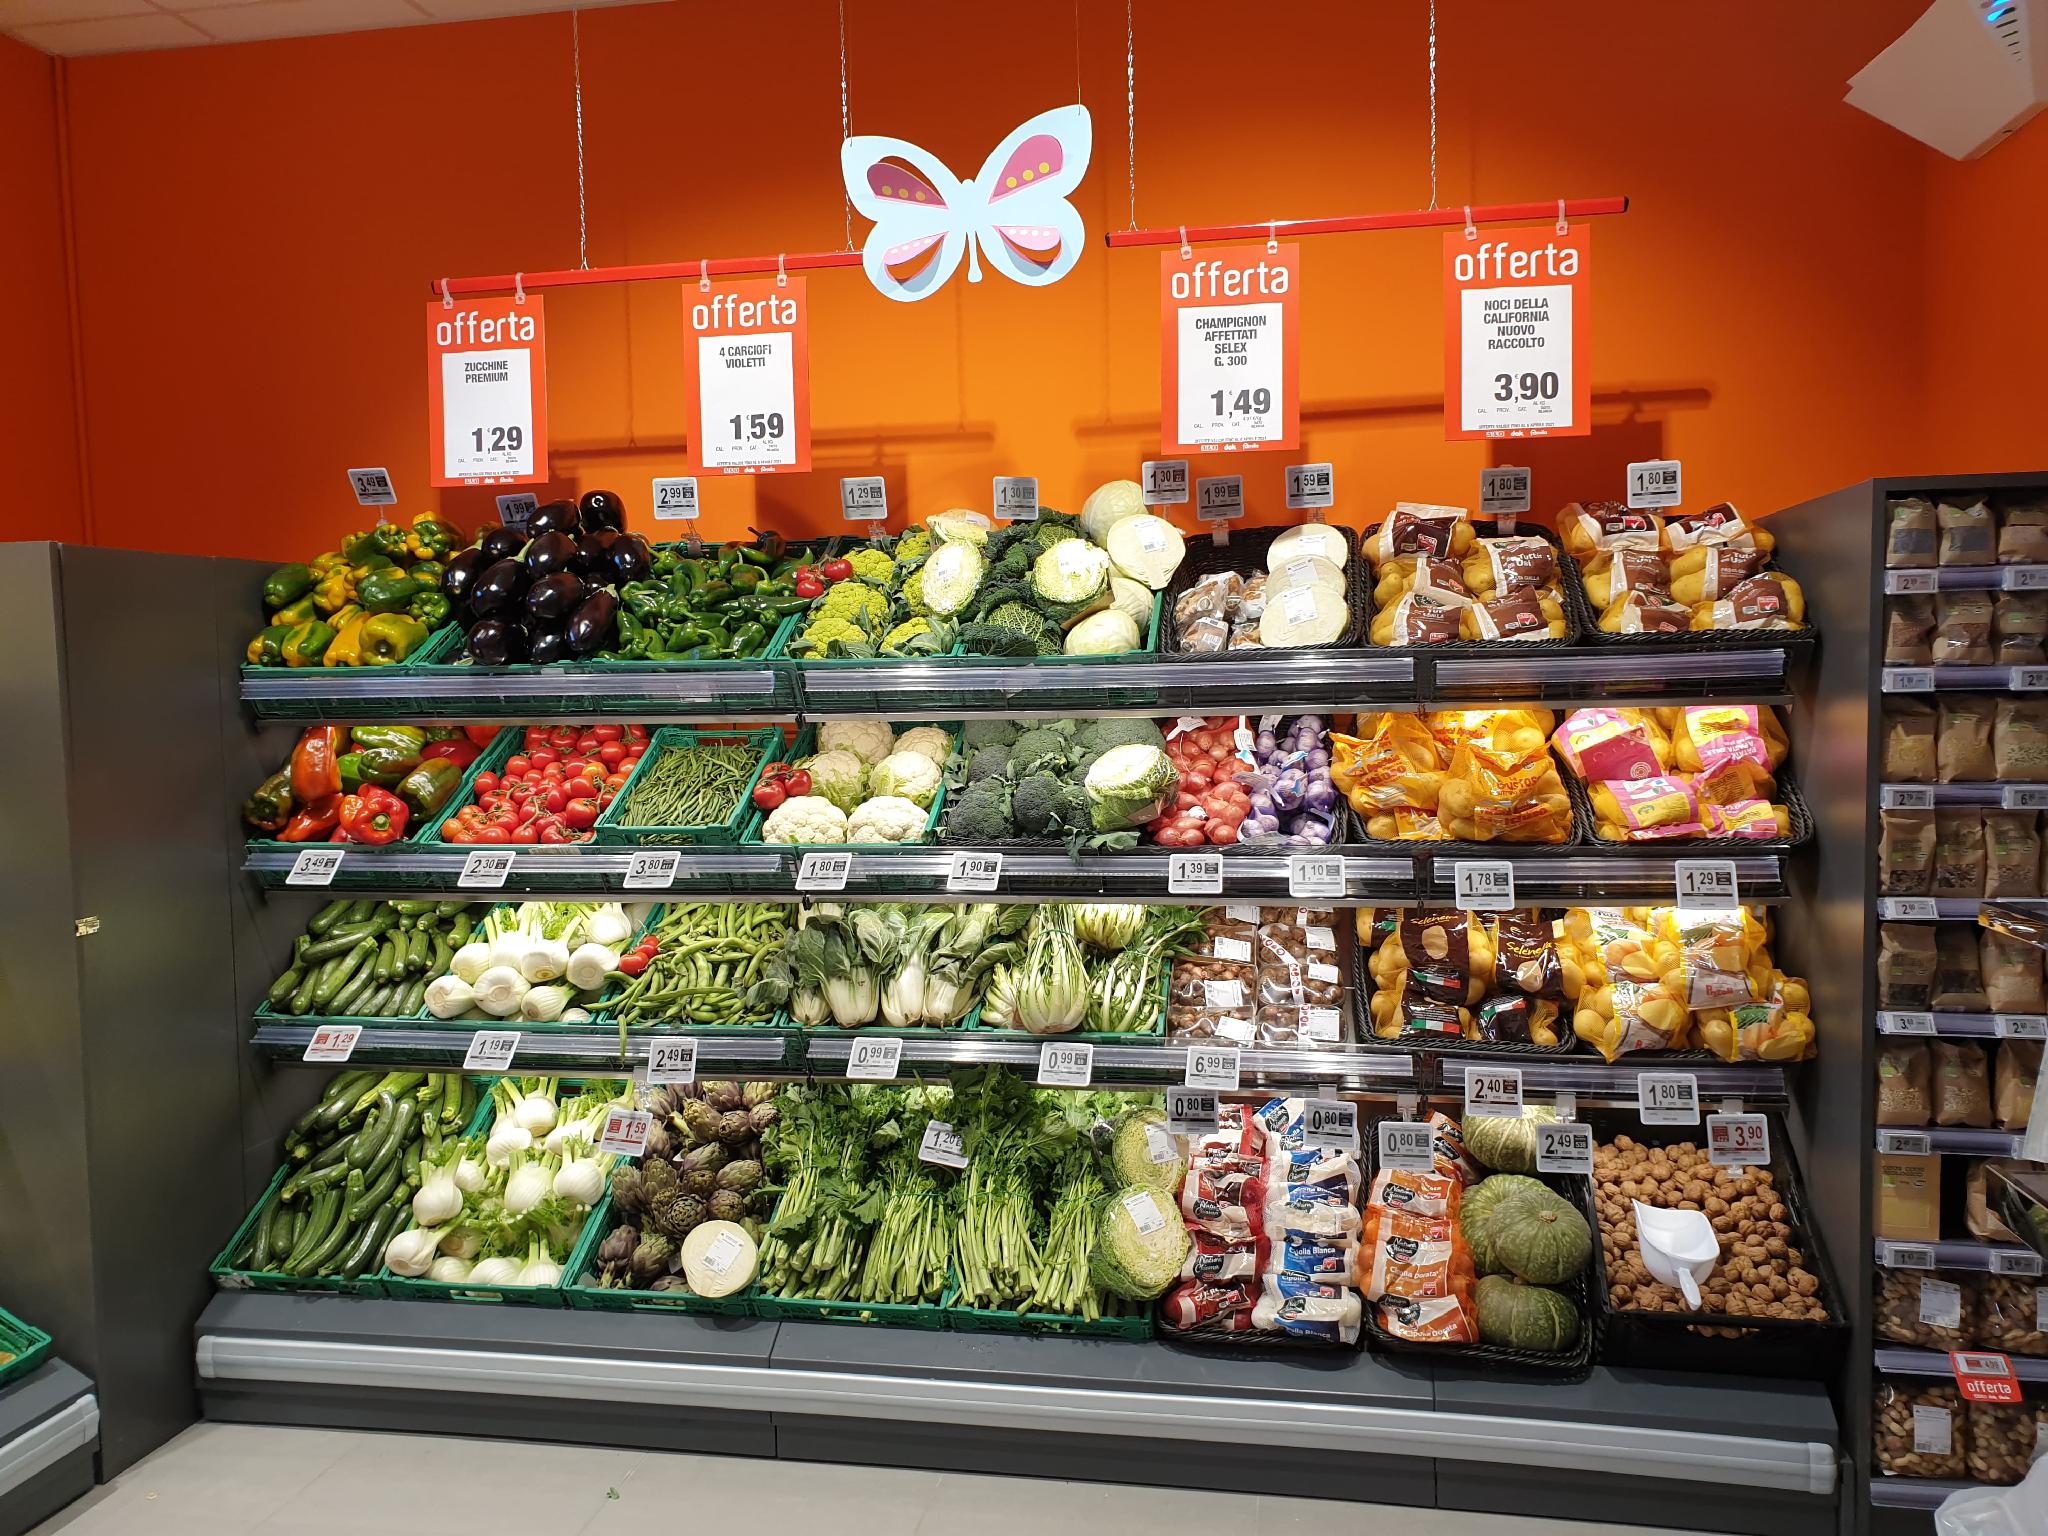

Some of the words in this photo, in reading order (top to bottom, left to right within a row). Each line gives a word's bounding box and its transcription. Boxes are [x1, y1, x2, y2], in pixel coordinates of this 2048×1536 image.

[1455, 242, 1579, 281] offerta
[1171, 261, 1289, 299] offerta
[692, 294, 797, 330] offerta
[1484, 299, 1511, 311] NOCI
[1514, 298, 1549, 310] DELLA
[1195, 315, 1267, 330] CHAMPIGNON
[1483, 311, 1550, 324] CALIFORNIA
[436, 310, 535, 346] offerta
[1204, 329, 1258, 341] AFFETTATI
[1497, 324, 1535, 336] NUOVO
[719, 347, 726, 357] 4
[728, 344, 772, 356] CARCIOFI
[1214, 342, 1247, 354] SELEX
[1488, 337, 1545, 350] RACCOLTO
[464, 360, 509, 372] ZUCCHINE
[725, 357, 766, 368] VIOLETTI
[1214, 357, 1224, 366] G.
[1227, 356, 1248, 366] 300
[465, 372, 508, 383] PREMIUM
[358, 476, 375, 493] 3,49
[1150, 472, 1170, 489] 1,30
[1294, 473, 1315, 493] 1,59
[1489, 478, 1511, 497] 1,80
[1638, 472, 1660, 491] 1,80
[660, 486, 681, 504] 2,99
[848, 487, 868, 504] 1,29
[1001, 486, 1020, 504] 1,30
[1205, 487, 1225, 504] 1,99
[505, 501, 524, 518] 1,99
[301, 858, 324, 871] 3,49
[470, 859, 494, 873] 2,30
[636, 860, 660, 874] 3,80
[810, 861, 831, 876] 1,80
[960, 861, 981, 876] 1,90
[1179, 863, 1202, 879] 1,39
[1299, 864, 1323, 881] 1,10
[1465, 873, 1491, 893] 1,78
[1686, 871, 1714, 893] 1,29
[334, 1034, 354, 1047] 1,29
[479, 1040, 499, 1055] 1,19
[656, 1050, 679, 1067] 2,49
[858, 1048, 881, 1063] 0,99
[1049, 1053, 1072, 1069] 0,99
[1196, 1057, 1219, 1073] 6,99
[1475, 1079, 1500, 1099] 2,40
[1649, 1086, 1675, 1105] 1,80
[1176, 1098, 1198, 1116] 0,80
[1313, 1111, 1336, 1131] 0,80
[625, 1121, 646, 1139] 1,59
[1735, 1127, 1762, 1146] 3,90
[1388, 1133, 1412, 1152] 0,80
[1545, 1134, 1571, 1155] 2,49
[1966, 1380, 2012, 1394] offerta
